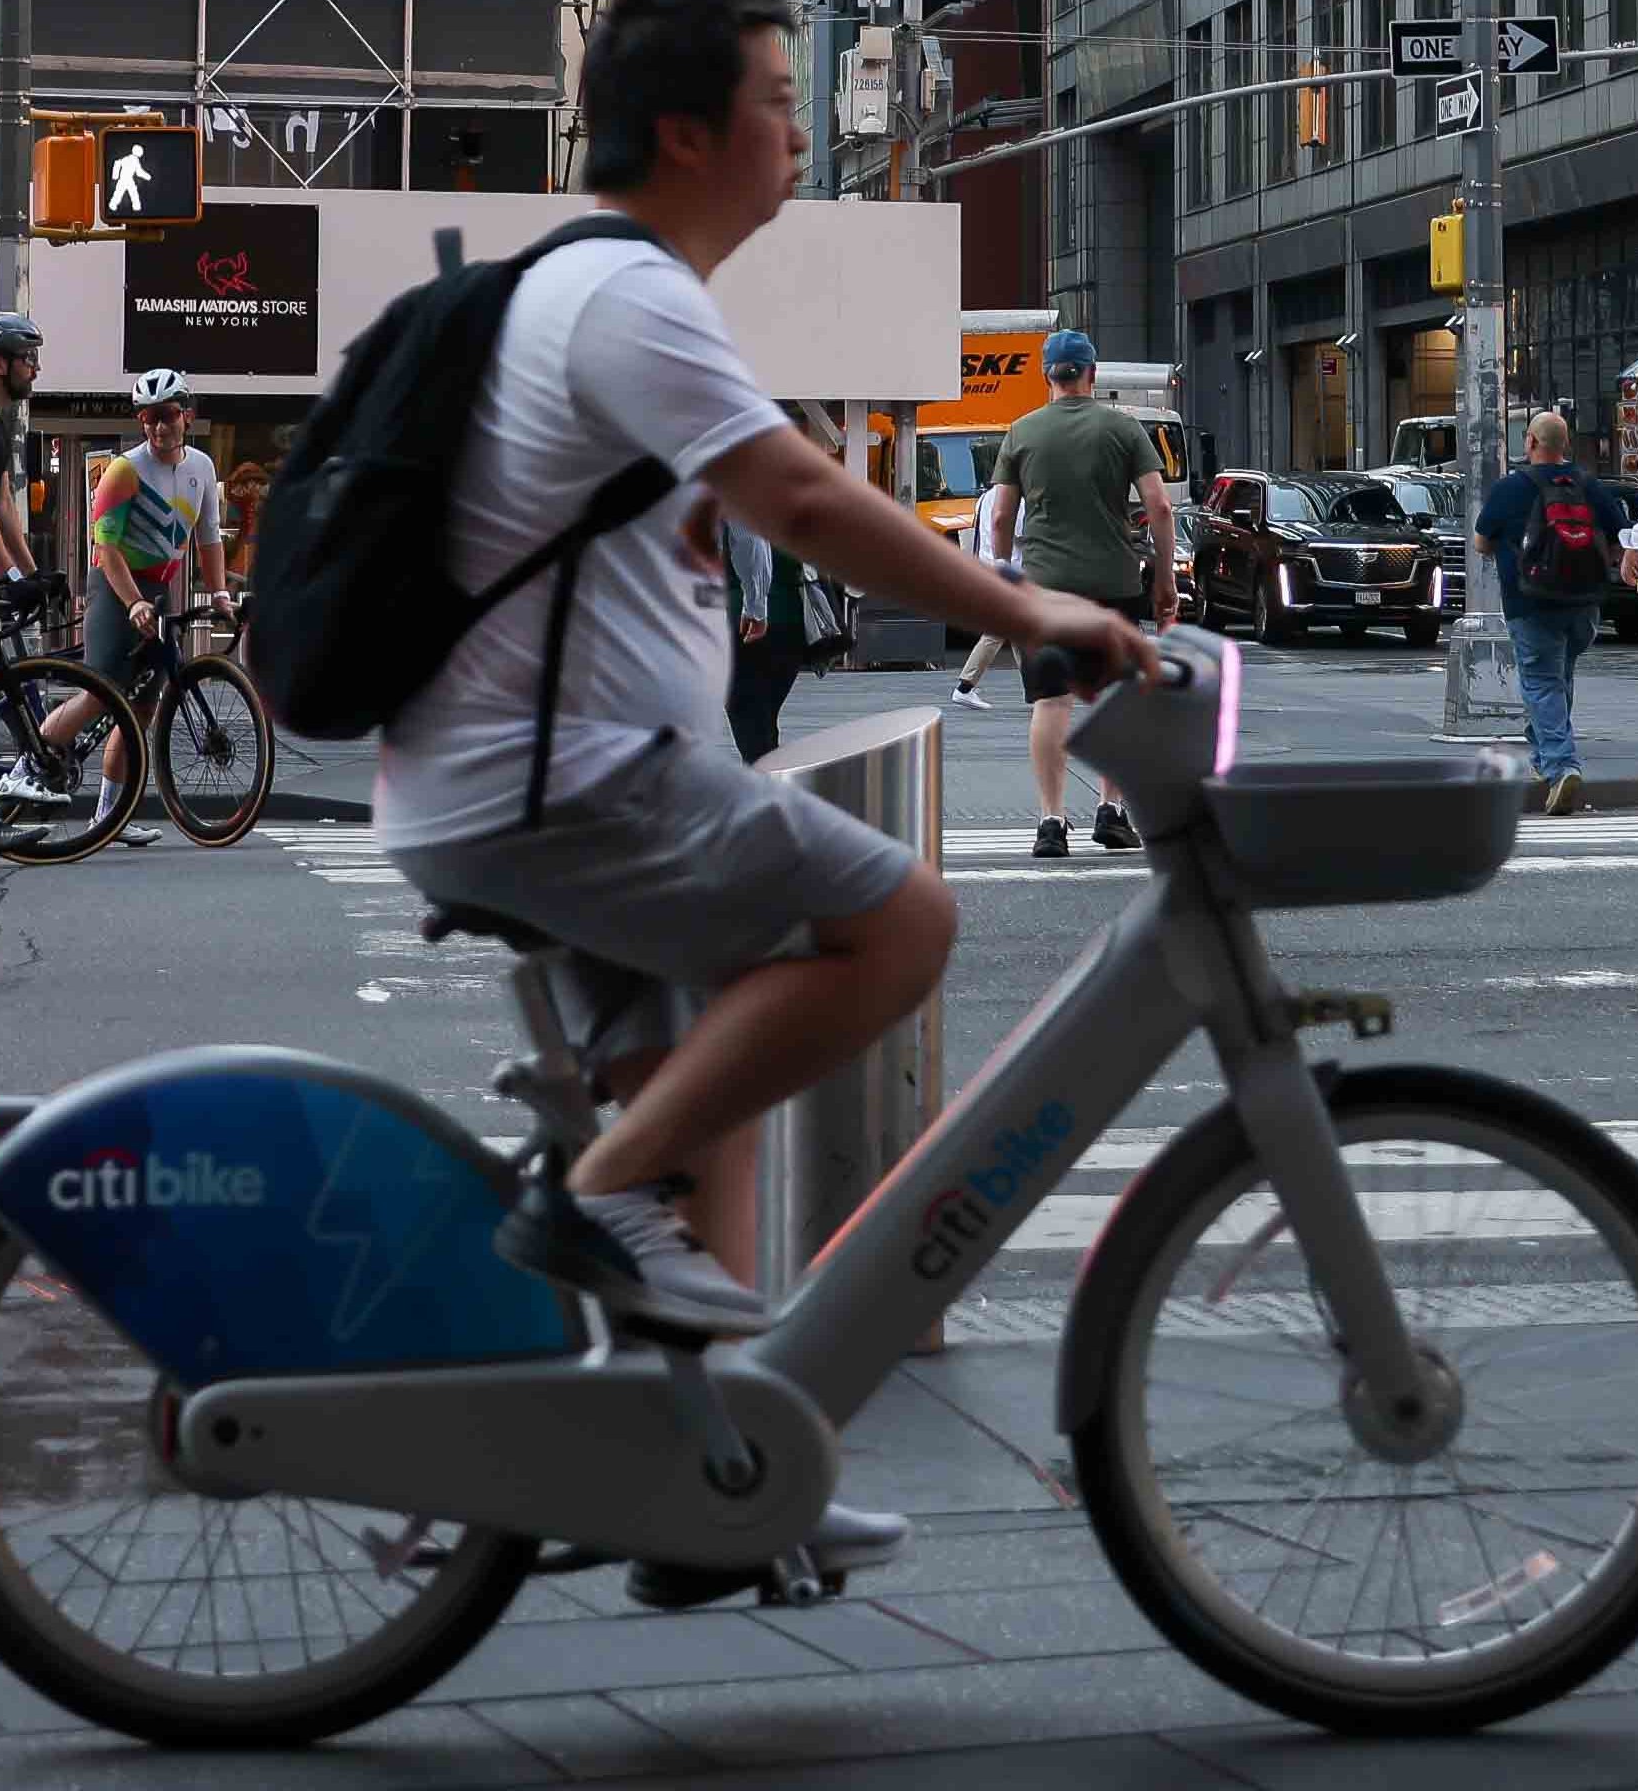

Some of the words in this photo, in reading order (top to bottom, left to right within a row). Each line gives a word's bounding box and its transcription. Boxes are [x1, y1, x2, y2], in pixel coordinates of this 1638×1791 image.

[1410, 38, 1454, 59] ONE
[1498, 37, 1523, 57] AY
[1441, 98, 1453, 119] ONE
[1458, 92, 1472, 114] WAY
[135, 298, 196, 312] TAMASHII
[186, 317, 214, 326] NEW
[221, 317, 259, 327] YORK
[962, 353, 1031, 377] SKE
[962, 380, 1001, 394] ental
[49, 1148, 136, 1211] citi
[143, 1152, 264, 1207] bike
[910, 1189, 985, 1283] citi
[977, 1101, 1076, 1208] bike
